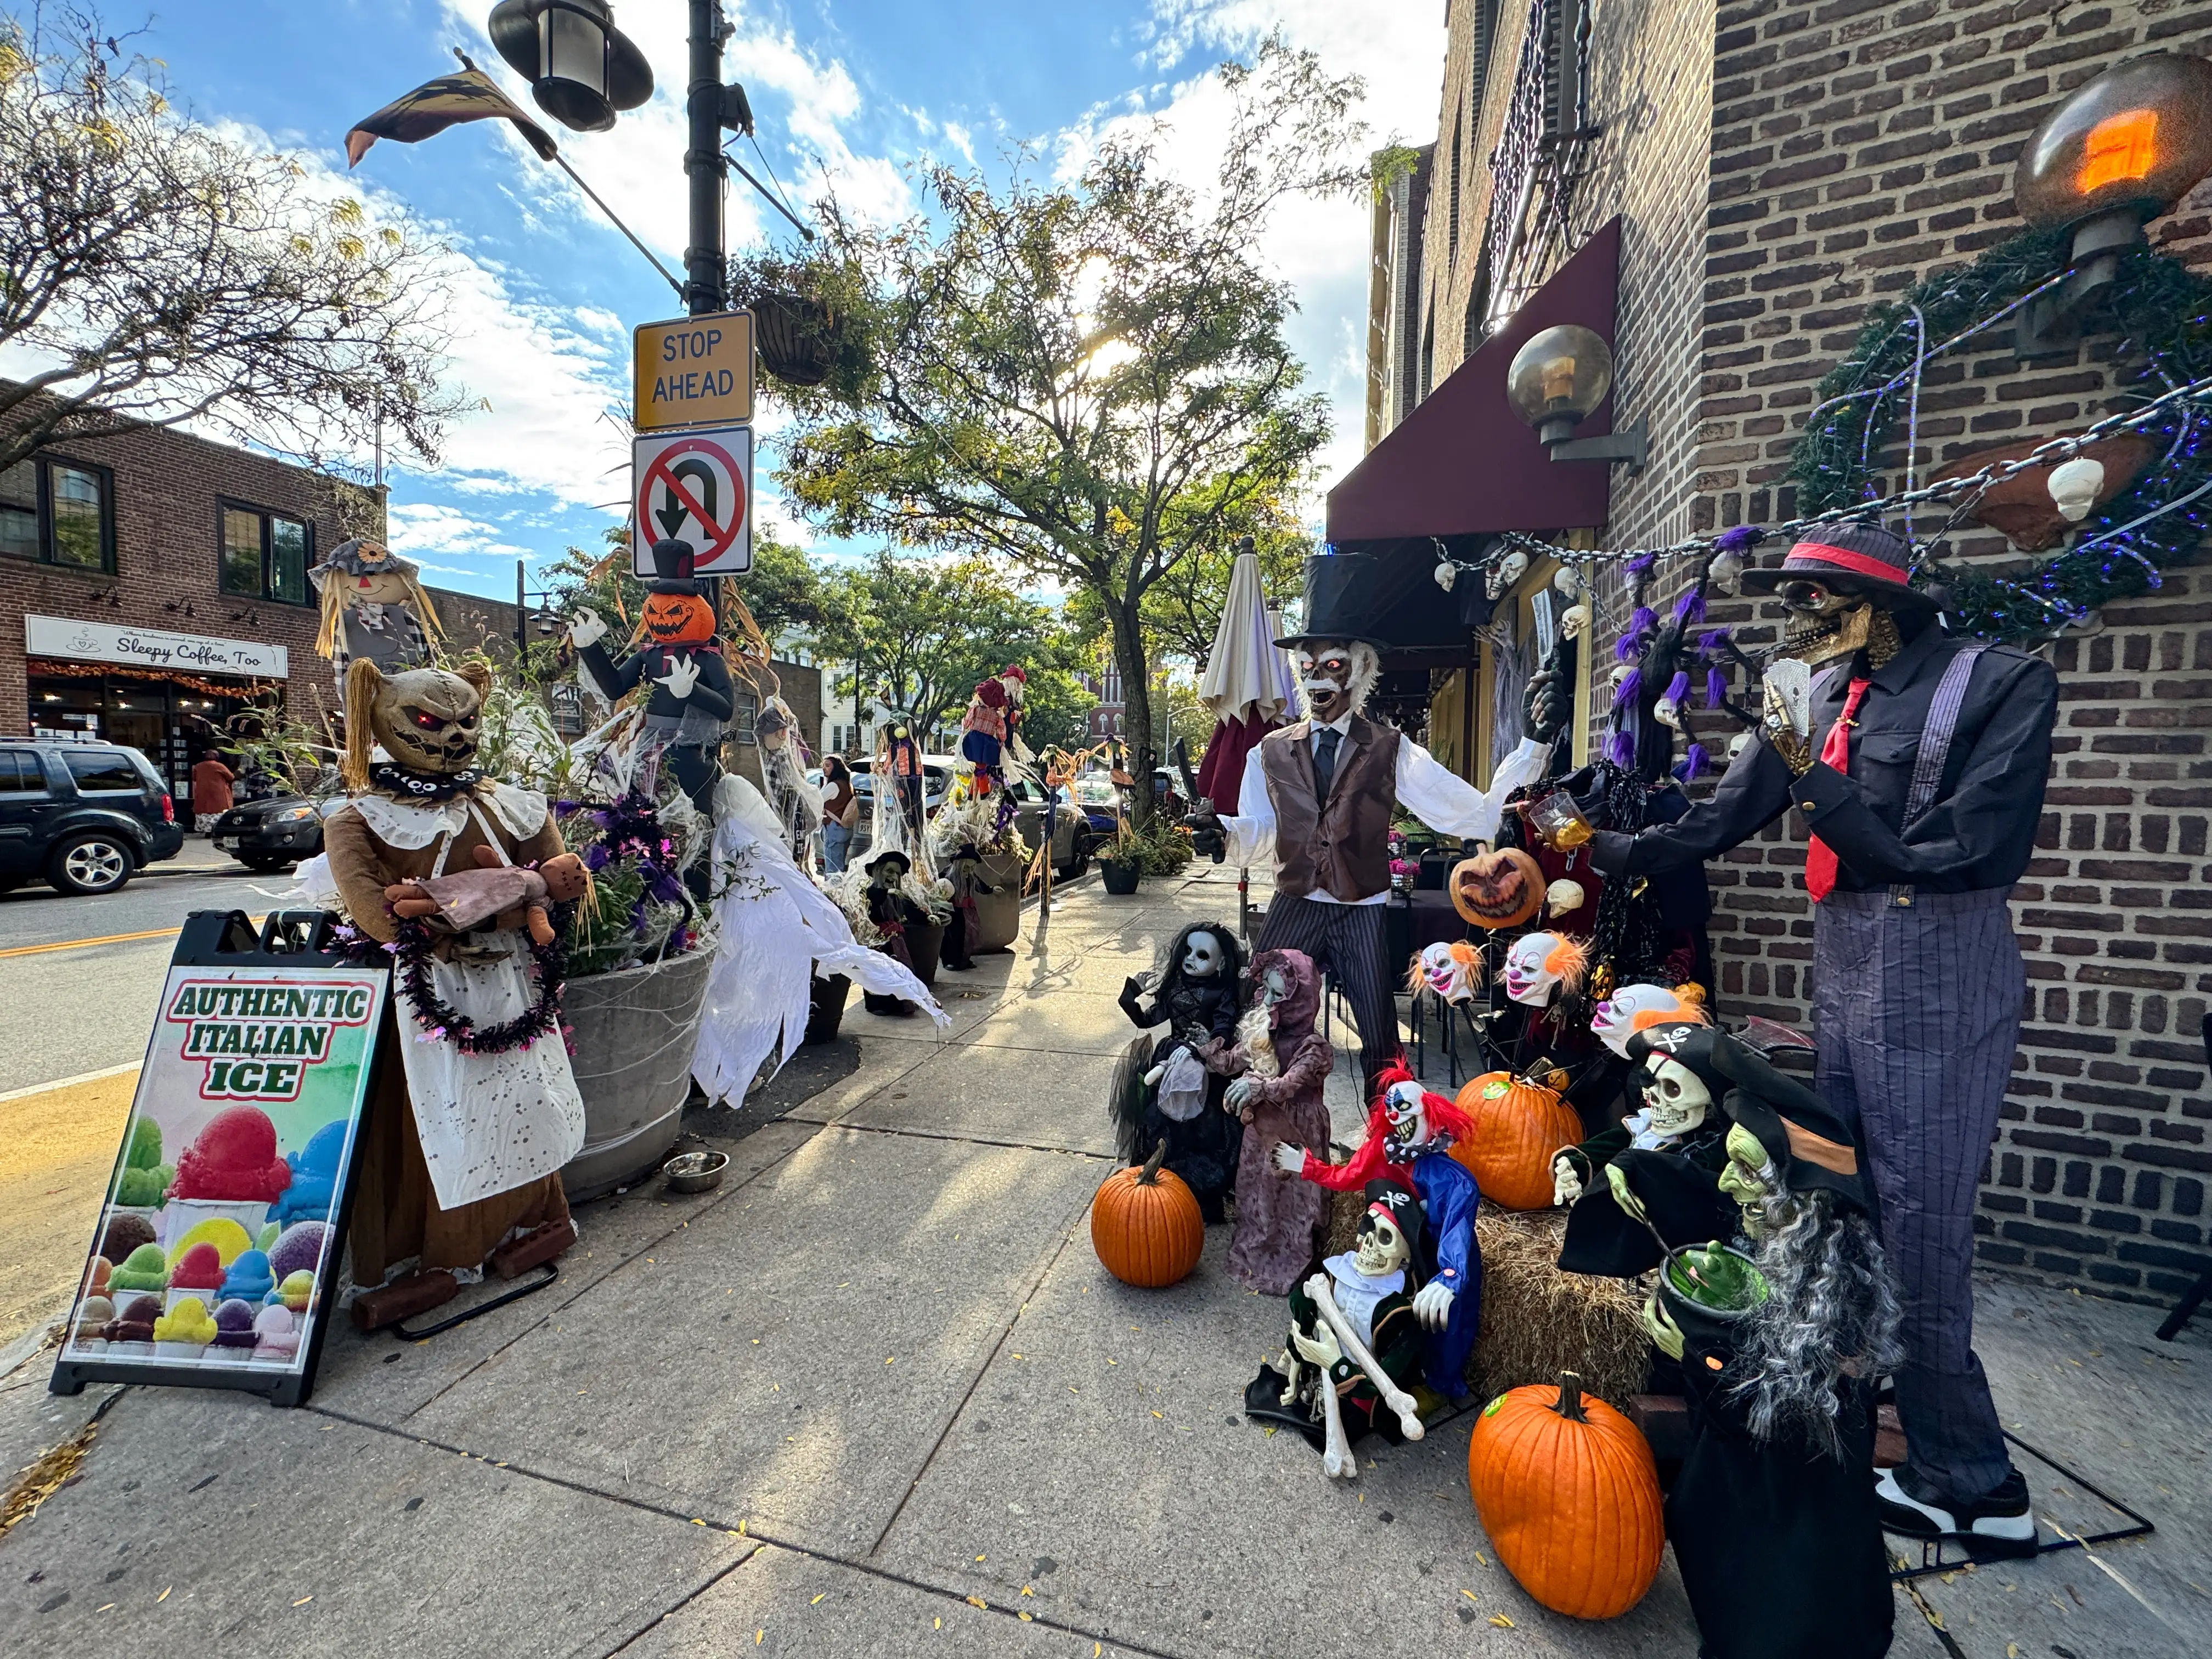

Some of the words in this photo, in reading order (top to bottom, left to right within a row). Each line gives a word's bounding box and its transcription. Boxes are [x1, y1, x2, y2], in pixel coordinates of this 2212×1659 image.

[663, 329, 722, 362] STOP
[652, 369, 733, 403] AHEAD
[117, 637, 173, 663] Sleepy
[177, 645, 227, 665] Coffee,
[233, 651, 262, 666] Too
[173, 986, 369, 1019] AUTHENTIC
[188, 1024, 327, 1056] ITALIAN
[207, 1062, 300, 1094] ICE
